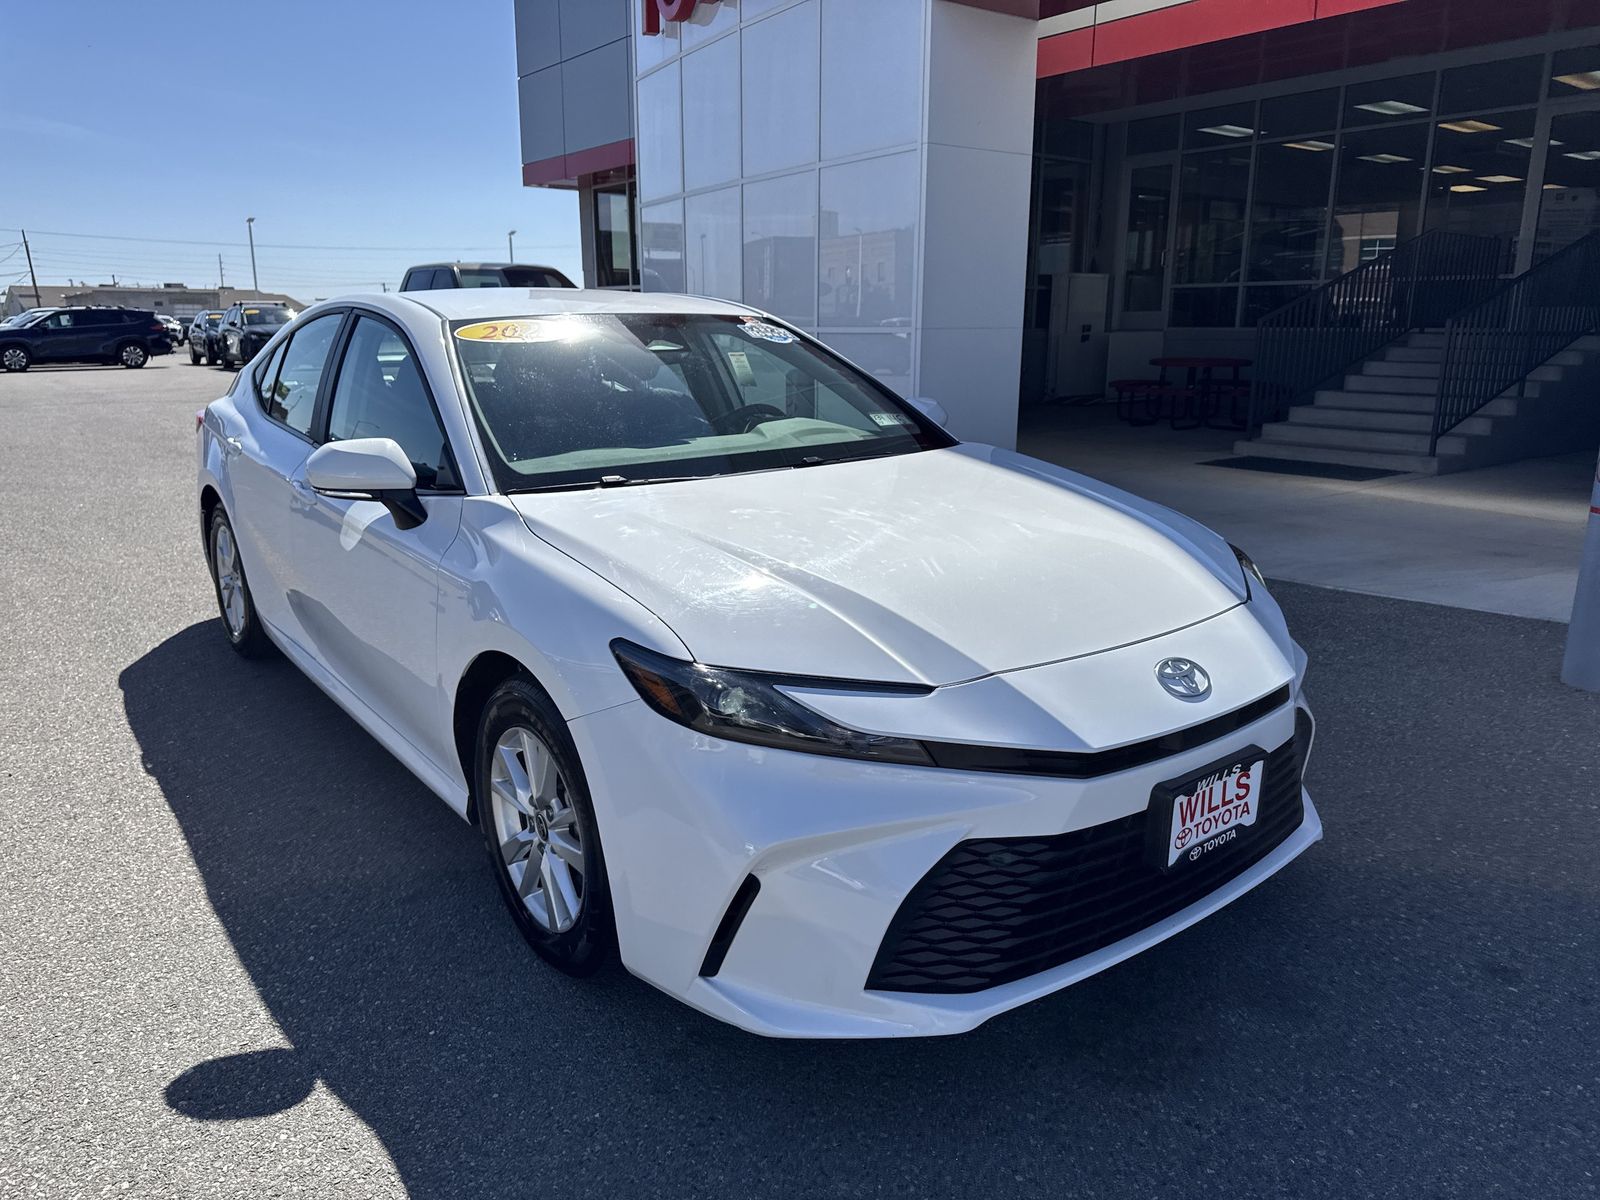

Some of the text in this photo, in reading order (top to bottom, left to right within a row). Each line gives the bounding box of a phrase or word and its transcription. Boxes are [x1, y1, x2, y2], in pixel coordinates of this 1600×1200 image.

[1196, 763, 1242, 792] WILLS
[1179, 771, 1251, 828] WILLS
[1193, 801, 1250, 839] TOYOTA
[1203, 829, 1237, 853] TOYOTA
